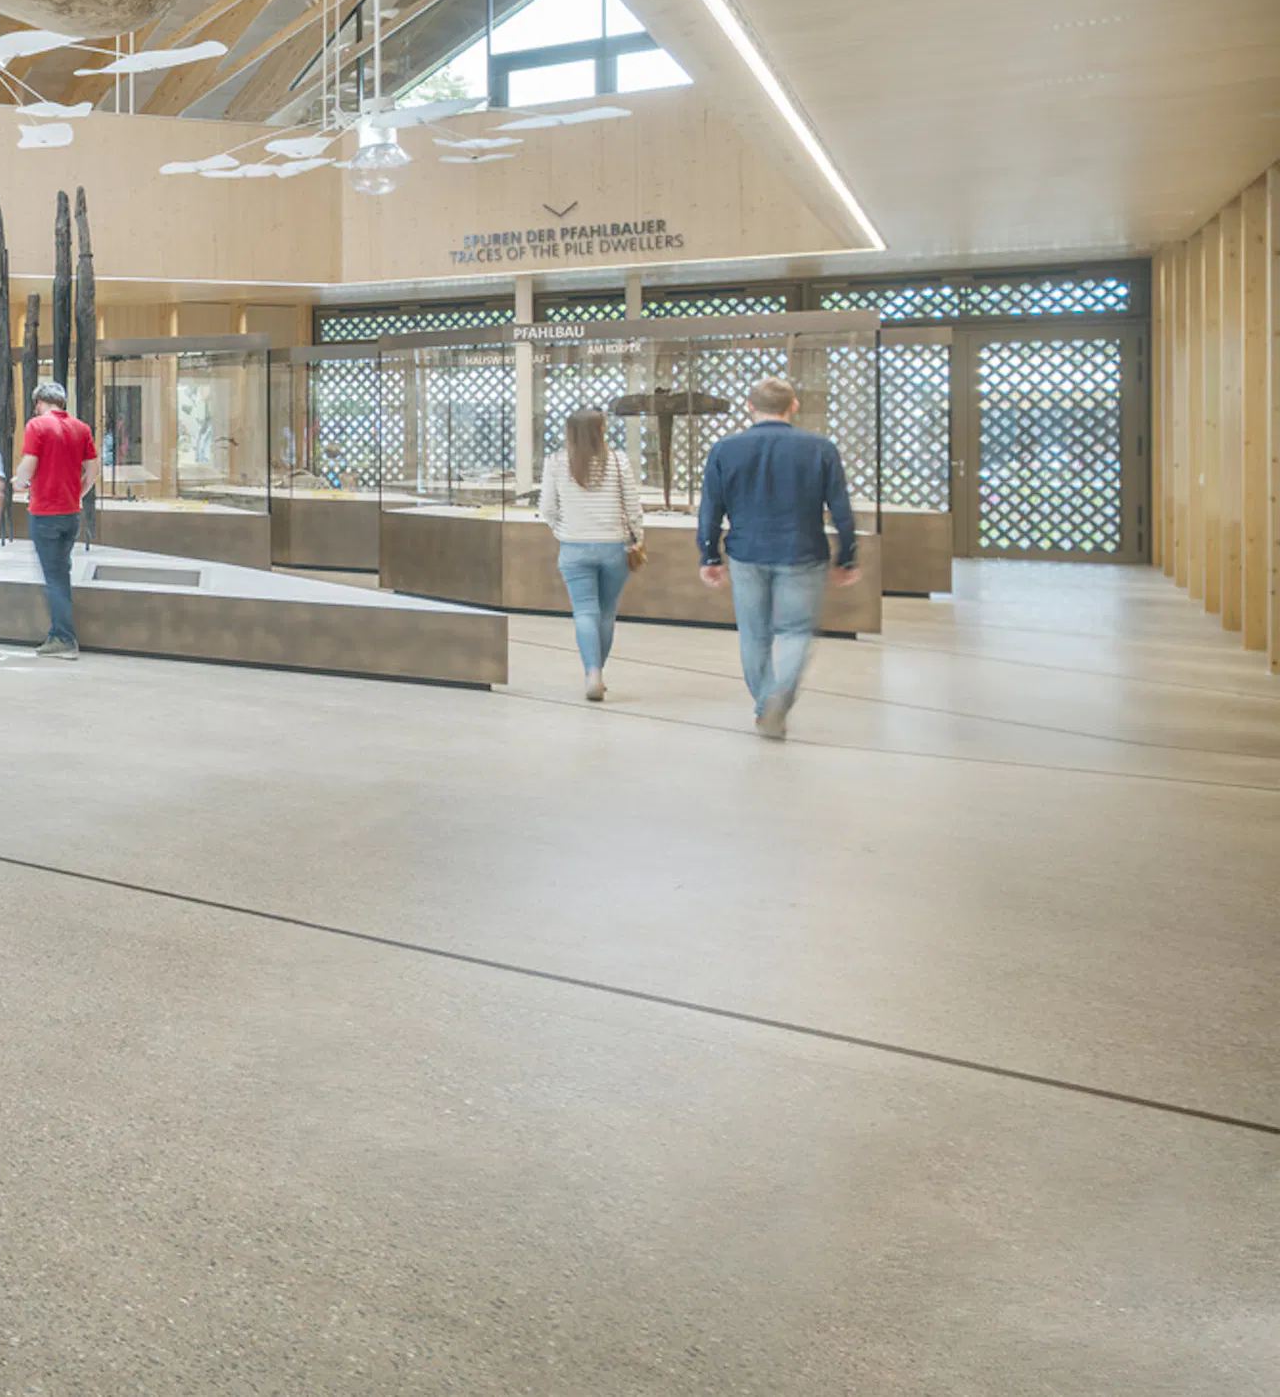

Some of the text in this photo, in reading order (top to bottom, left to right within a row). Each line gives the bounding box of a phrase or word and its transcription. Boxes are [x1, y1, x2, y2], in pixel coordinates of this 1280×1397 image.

[449, 234, 684, 264] TRACES OF THE PILE DWELLERS
[463, 219, 667, 249] SPUREN DER PFAHLBAUER
[513, 325, 585, 339] PFAHLBAU
